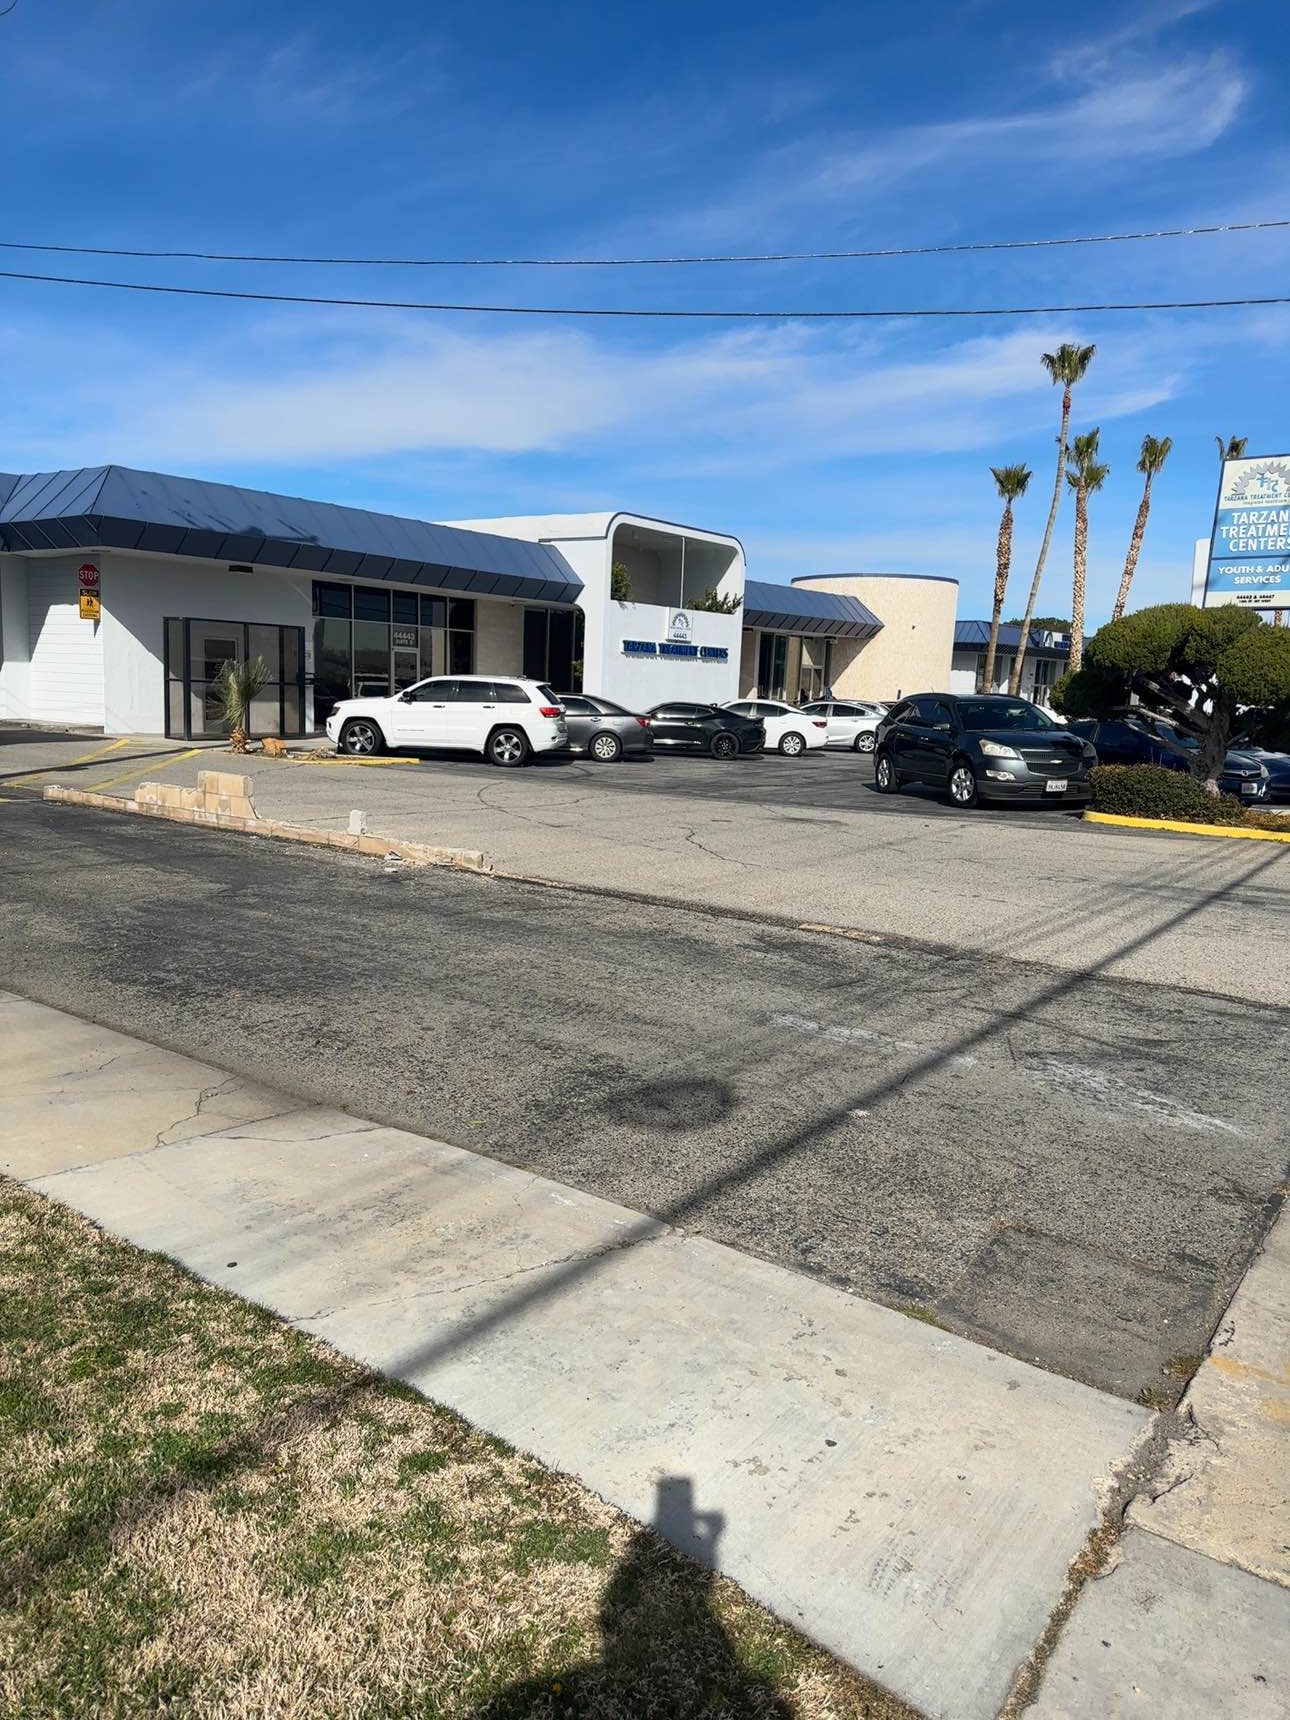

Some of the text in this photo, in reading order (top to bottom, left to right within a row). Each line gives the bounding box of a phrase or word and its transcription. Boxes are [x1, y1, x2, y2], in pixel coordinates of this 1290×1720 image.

[1220, 524, 1290, 538] TREATME
[1218, 566, 1254, 574] YOUTH
[1256, 565, 1263, 573] &
[80, 570, 99, 580] STOP
[1233, 575, 1281, 584] SERVICES
[394, 632, 415, 640] 44443
[623, 640, 729, 659] TARZANA TREATMENT CENTERS
